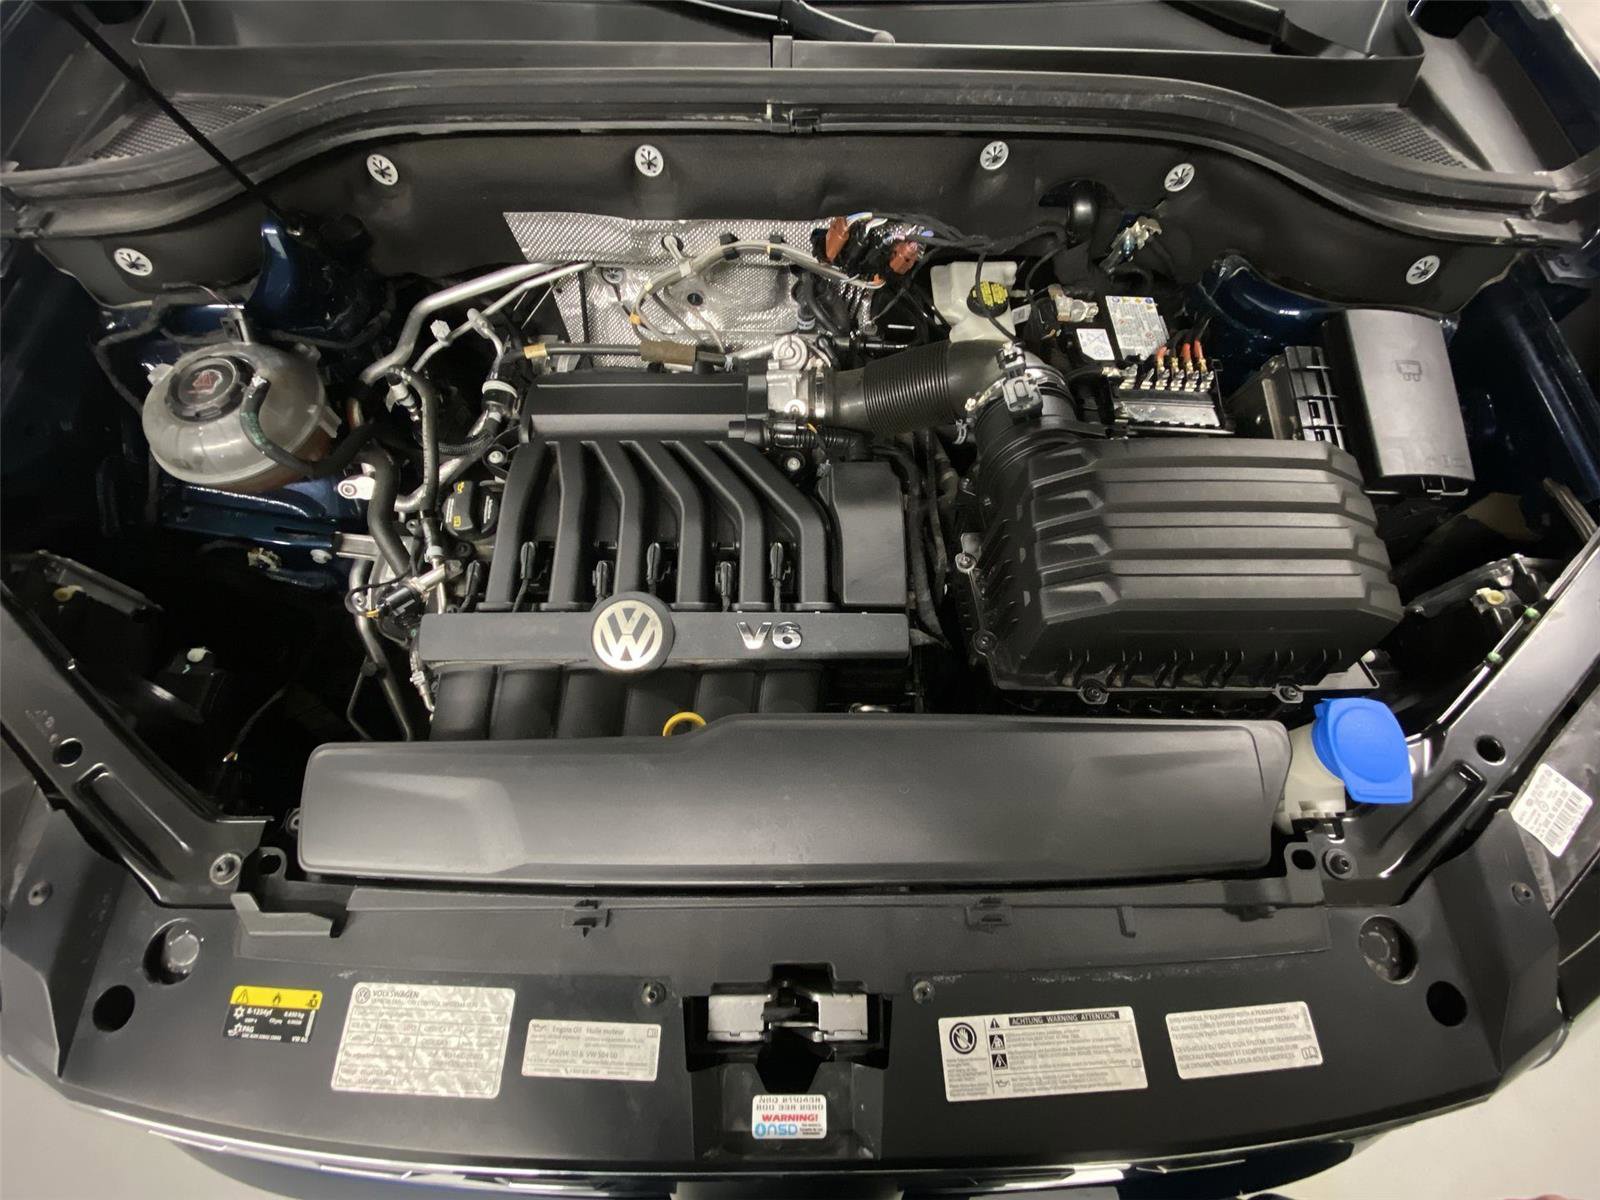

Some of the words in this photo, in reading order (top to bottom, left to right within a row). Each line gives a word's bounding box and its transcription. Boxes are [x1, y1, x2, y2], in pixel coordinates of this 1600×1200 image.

[736, 621, 803, 651] V6
[1012, 1017, 1044, 1025] ACHTUNG
[1046, 1014, 1078, 1023] WARNING
[1081, 1011, 1116, 1021] ATTENTION
[762, 1113, 819, 1122] WARNING!
